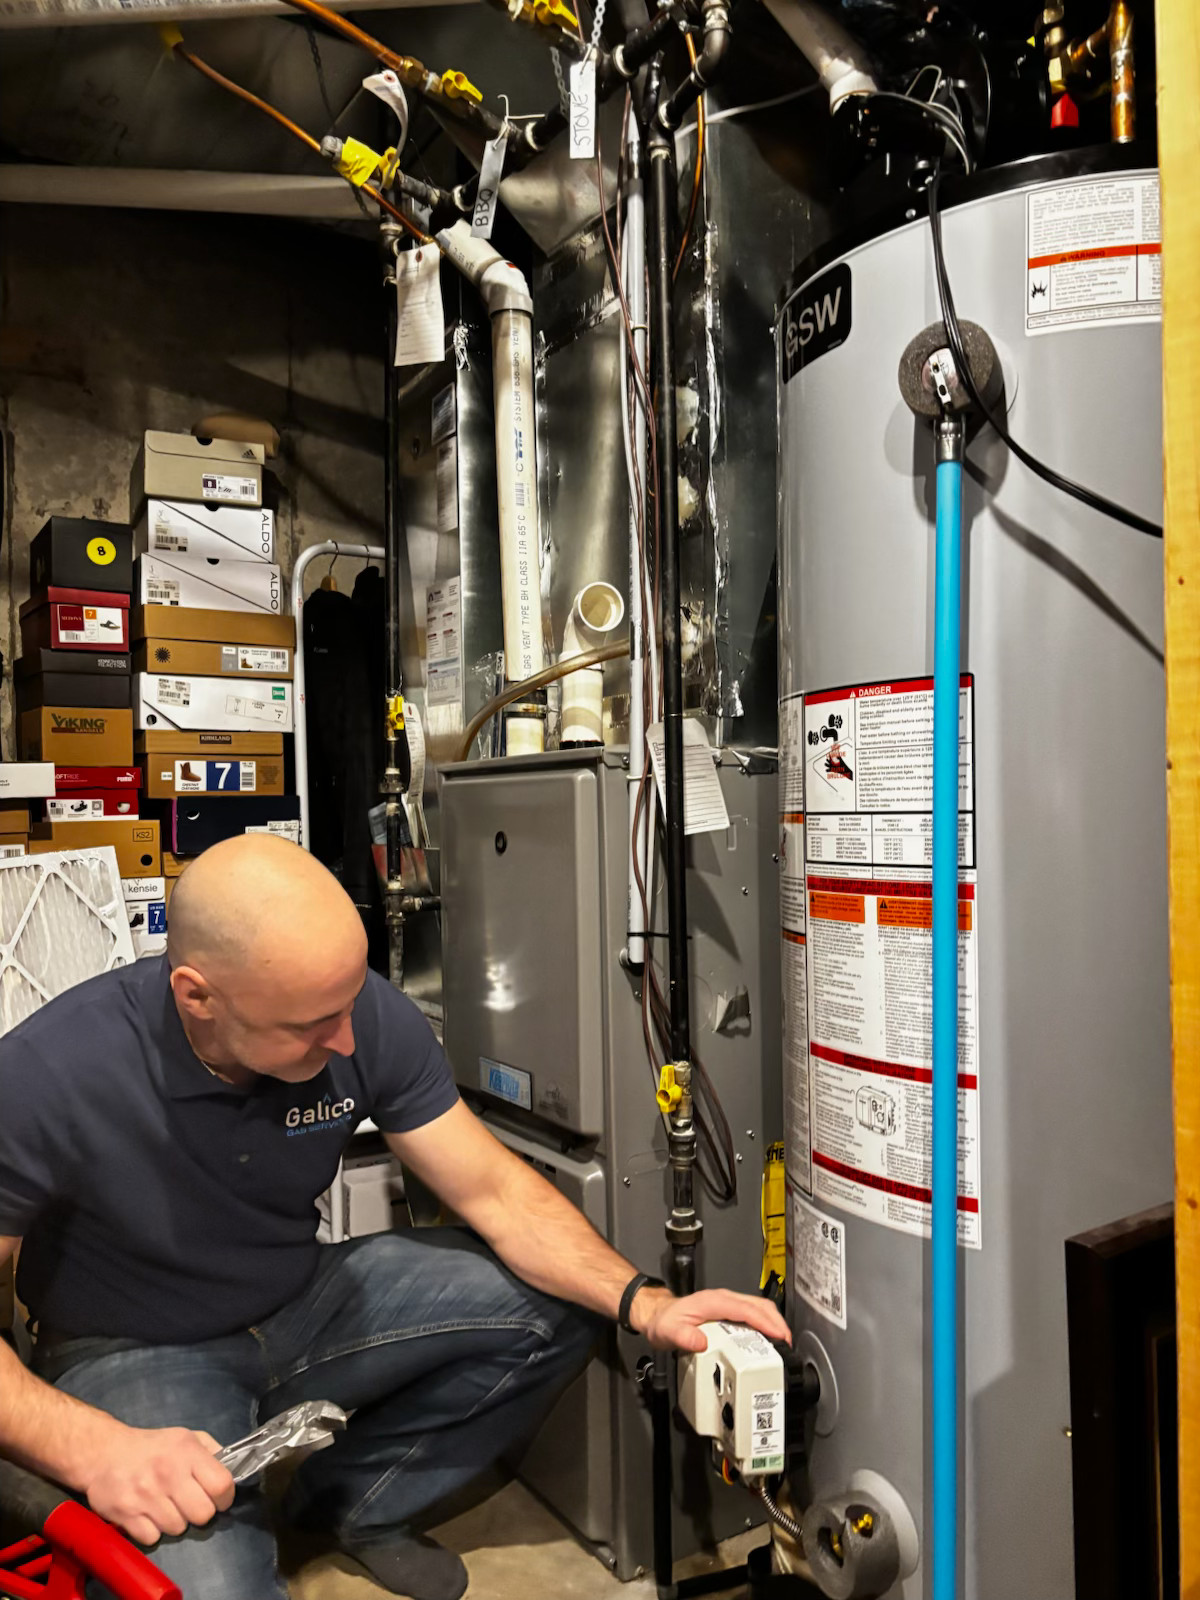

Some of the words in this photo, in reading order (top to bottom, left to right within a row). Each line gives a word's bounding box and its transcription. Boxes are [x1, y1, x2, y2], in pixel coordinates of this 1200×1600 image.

[572, 94, 591, 146] STOVE
[475, 189, 493, 227] BBQ
[785, 286, 842, 360] GSW
[261, 513, 270, 554] ALDO
[520, 561, 528, 586] CLASS
[521, 590, 529, 600] BH
[522, 605, 530, 625] TYPE
[523, 630, 531, 650] VENT
[858, 686, 891, 697] DANGER
[215, 762, 231, 790] 7
[128, 884, 158, 893] kensie
[154, 911, 160, 924] 7
[286, 1098, 355, 1127] Galico
